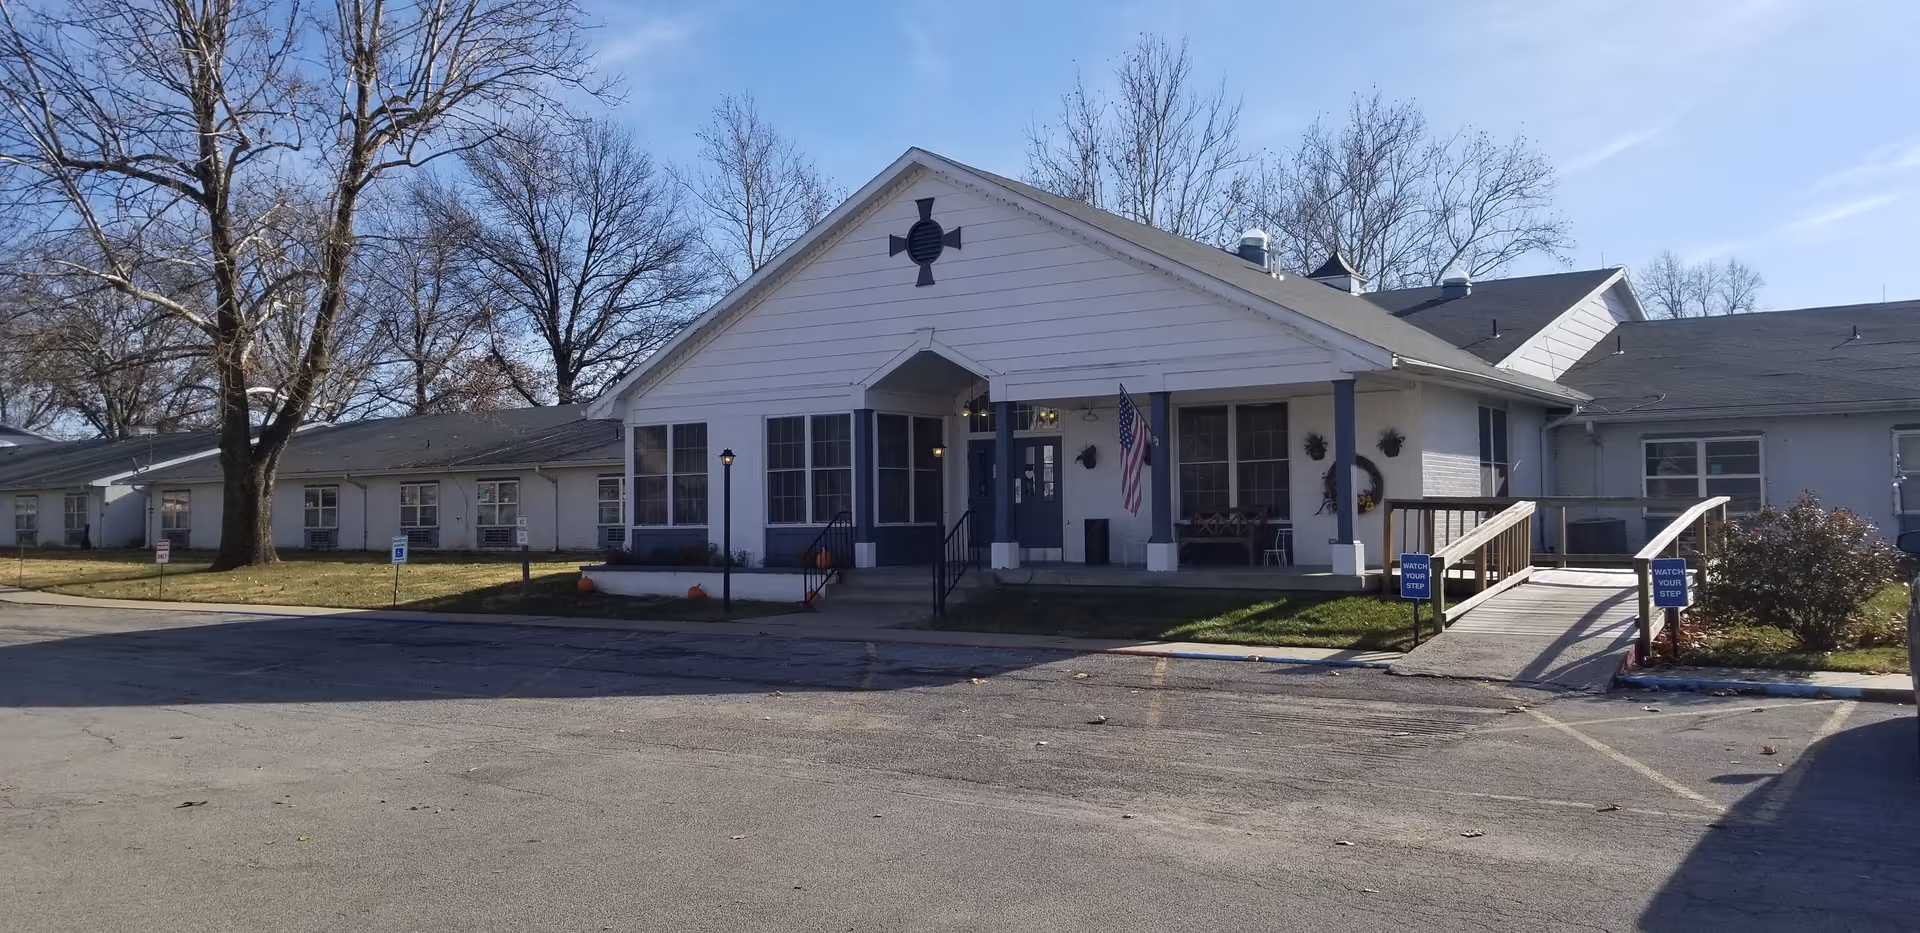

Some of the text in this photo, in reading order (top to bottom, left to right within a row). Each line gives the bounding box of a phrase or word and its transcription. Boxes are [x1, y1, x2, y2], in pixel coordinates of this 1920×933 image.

[1403, 562, 1428, 570] WATCH
[1405, 572, 1426, 580] YOUR
[1654, 568, 1684, 576] WATCH
[1406, 582, 1425, 590] STEP
[1658, 579, 1682, 587] YOUR
[1659, 590, 1682, 598] STEP
